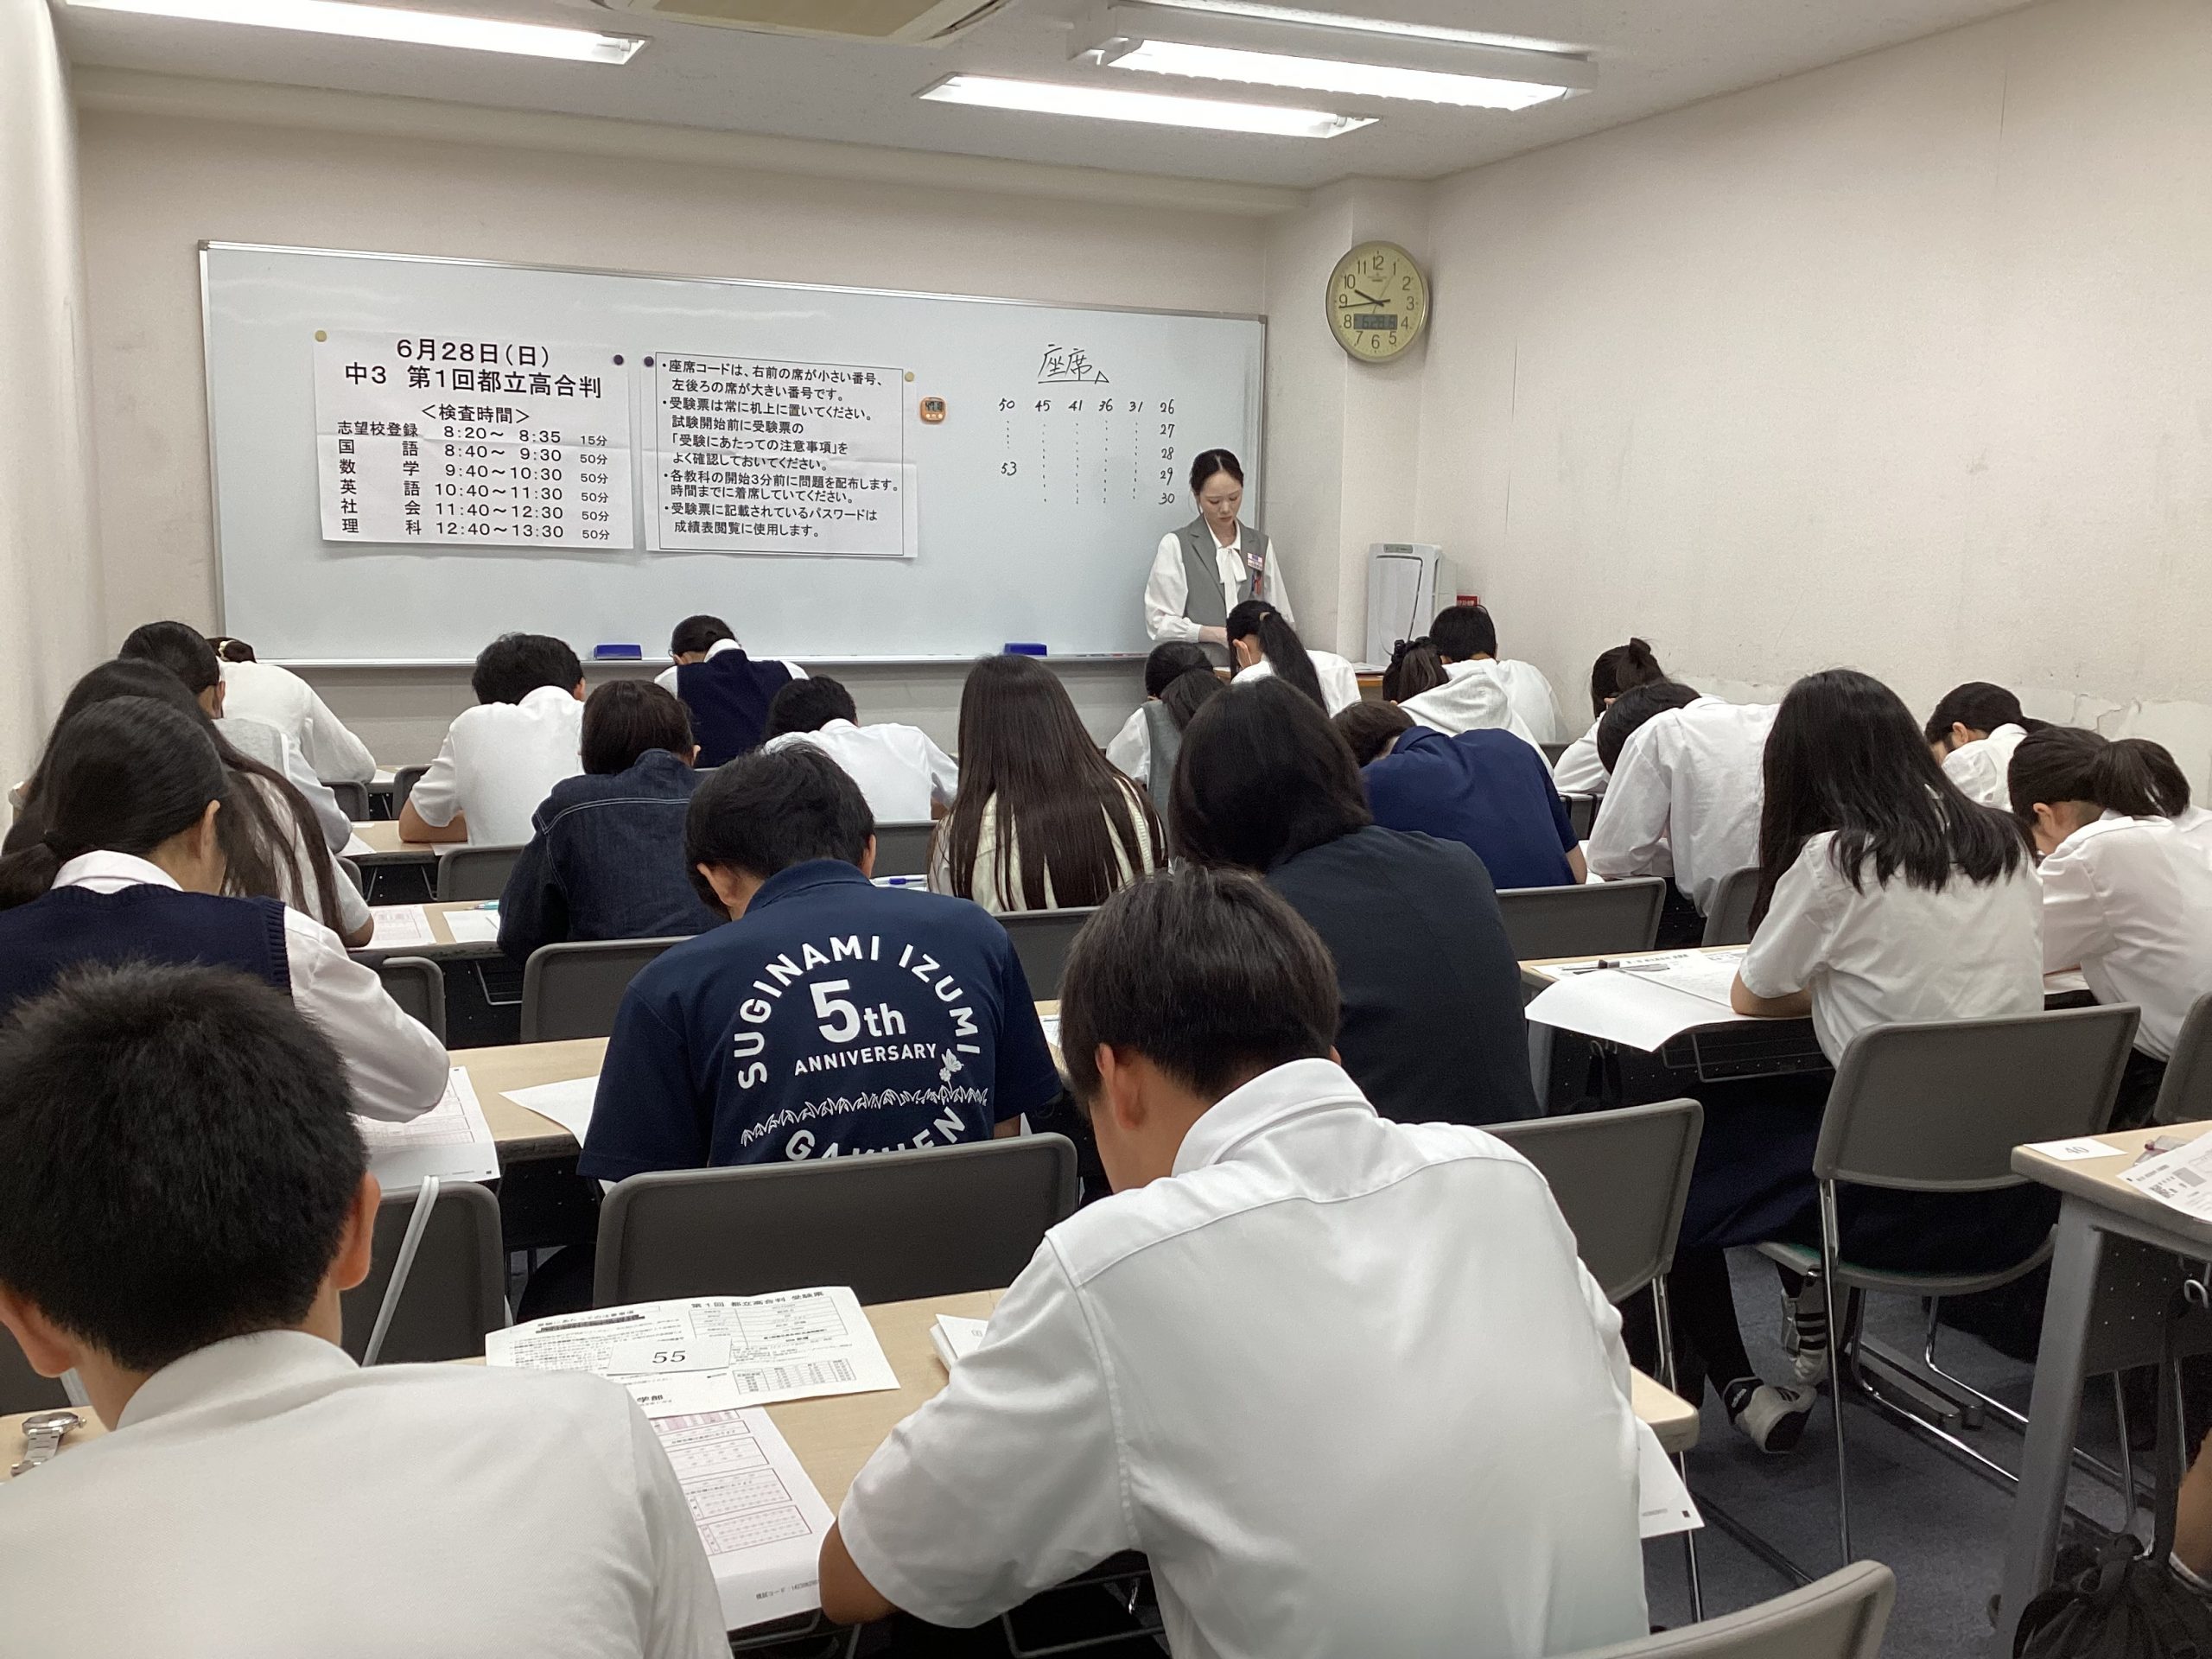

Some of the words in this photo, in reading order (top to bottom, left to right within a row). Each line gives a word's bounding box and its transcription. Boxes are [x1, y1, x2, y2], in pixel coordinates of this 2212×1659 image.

[1357, 260, 1366, 274] 11
[1373, 256, 1384, 270] 12
[1393, 262, 1396, 276] 1
[1344, 274, 1356, 289] 10
[1402, 276, 1411, 290] 2
[1406, 296, 1414, 310] 3
[1344, 315, 1351, 328] 8
[1401, 316, 1408, 329] 4
[1356, 331, 1363, 344] 7
[1372, 334, 1380, 349] 6
[1389, 331, 1396, 345] 5
[345, 362, 387, 385] 中3
[407, 365, 601, 398] 第1回都立高合判
[999, 398, 1015, 412] 50
[1034, 399, 1051, 412] 45
[1068, 399, 1083, 411] 41
[1098, 398, 1113, 412] 36
[1128, 401, 1143, 413] 31
[1160, 399, 1174, 415] 26
[338, 421, 418, 437] 志望校登録
[518, 430, 561, 443] 8:35
[580, 435, 607, 446] 15分
[1160, 423, 1175, 439] 27
[580, 454, 607, 465] 50分
[1160, 446, 1174, 460] 28
[1001, 461, 1017, 476] 53
[580, 472, 608, 484] 50分
[1160, 467, 1173, 486] 29
[581, 492, 609, 503] 50分
[1159, 493, 1175, 505] 30
[582, 510, 609, 521] 50分
[582, 529, 609, 541] 50分
[734, 934, 880, 1090] SUGINAMI
[898, 943, 981, 1055] IZUMI
[810, 979, 906, 1044] 5th
[794, 1043, 938, 1077] ANNIVERSARY
[652, 1350, 686, 1363] 55
